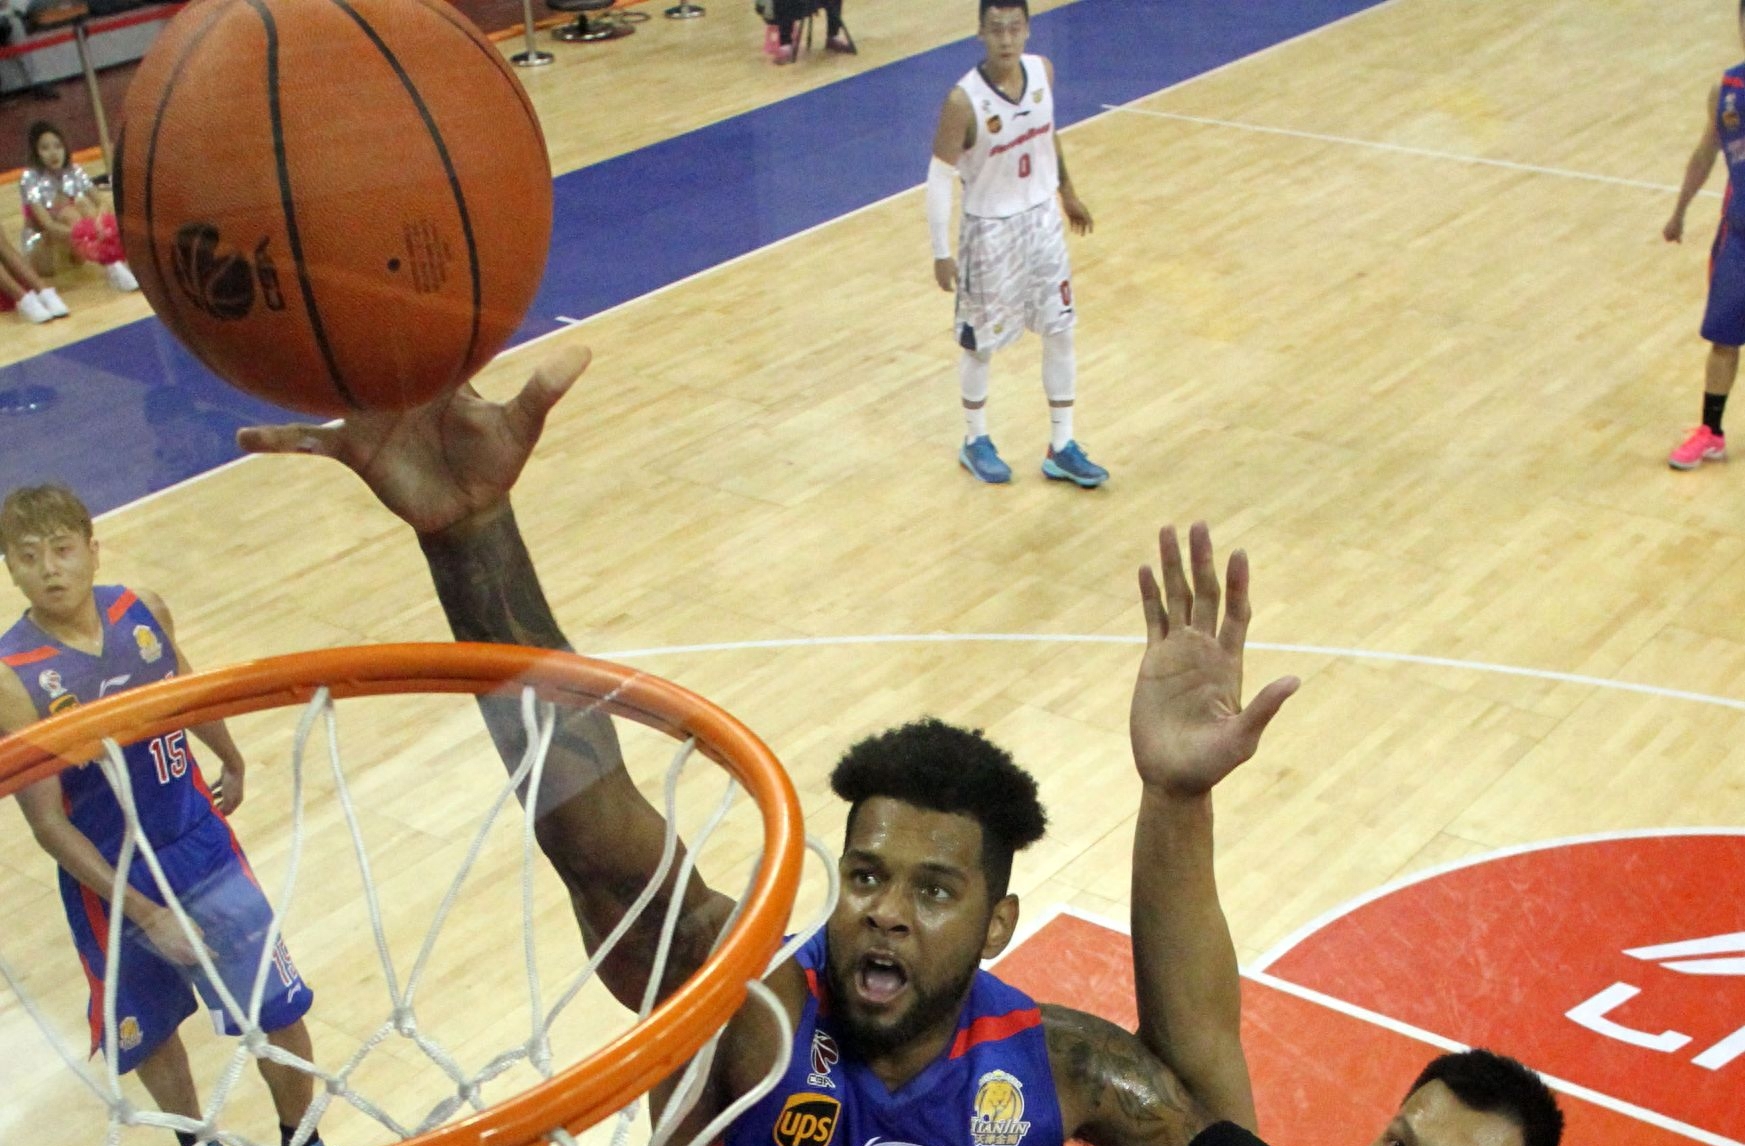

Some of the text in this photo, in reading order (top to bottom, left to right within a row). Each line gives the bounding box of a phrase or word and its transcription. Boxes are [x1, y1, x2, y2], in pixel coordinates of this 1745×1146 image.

[1018, 153, 1031, 178] 0
[149, 729, 188, 784] 15
[781, 1111, 831, 1146] ups
